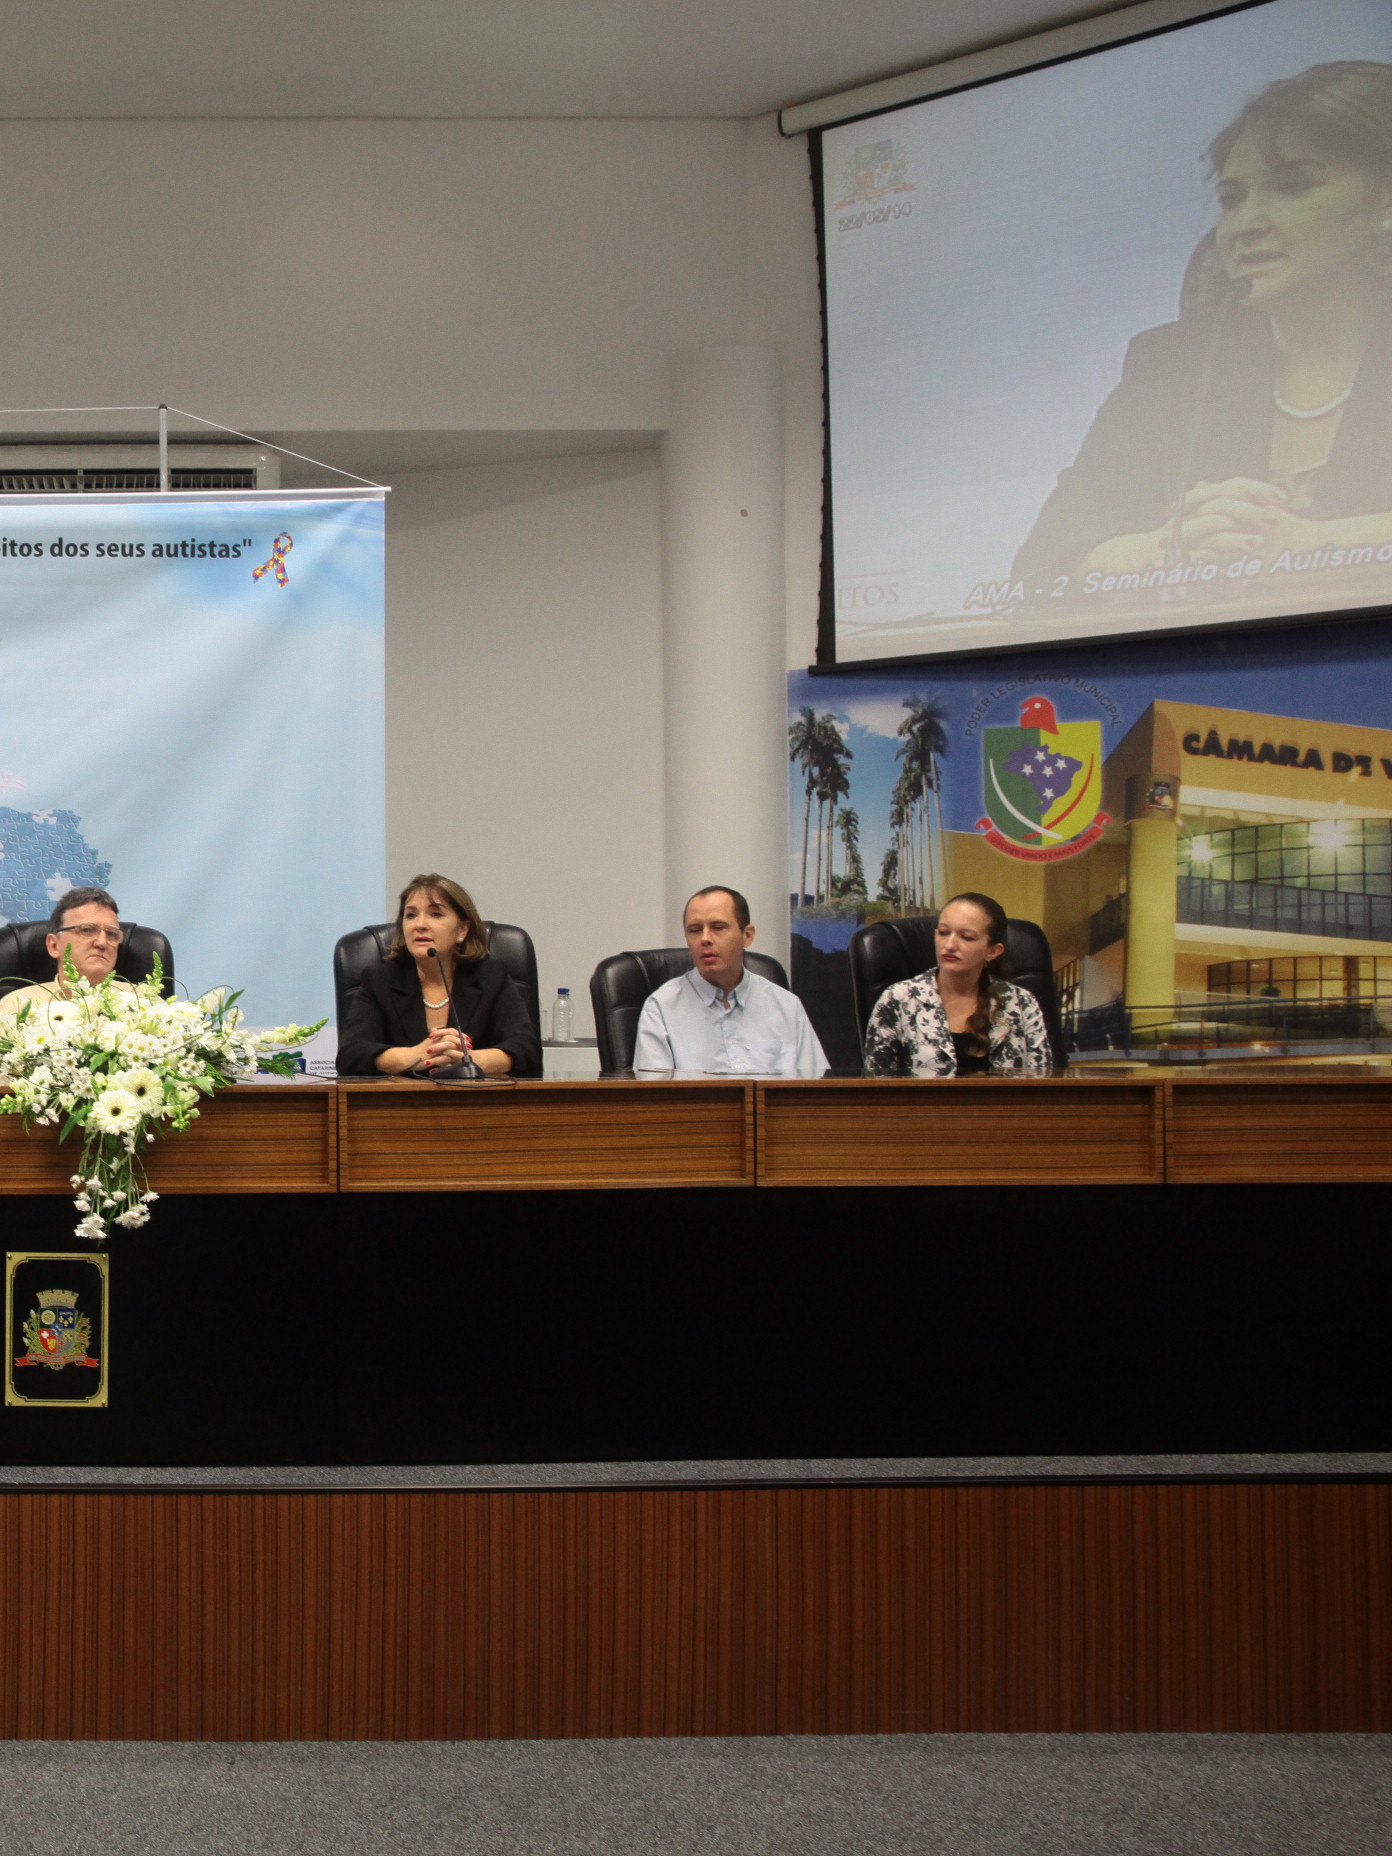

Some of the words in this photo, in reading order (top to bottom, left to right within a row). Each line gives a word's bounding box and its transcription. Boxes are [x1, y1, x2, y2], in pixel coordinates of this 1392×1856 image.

[50, 537, 90, 558] dos
[96, 540, 146, 558] seus
[151, 538, 252, 559] autistas"
[964, 580, 1025, 610] AMA
[1050, 575, 1069, 598] 2
[1082, 561, 1218, 594] Seminário
[1226, 555, 1262, 579] de
[1270, 544, 1392, 574] Autismo
[964, 697, 991, 737] PODER
[991, 673, 1071, 700] LEGISLATIVO
[1074, 678, 1123, 728] MUNICIPAL
[1182, 728, 1325, 772] CÂMARA
[1331, 751, 1372, 777] DE
